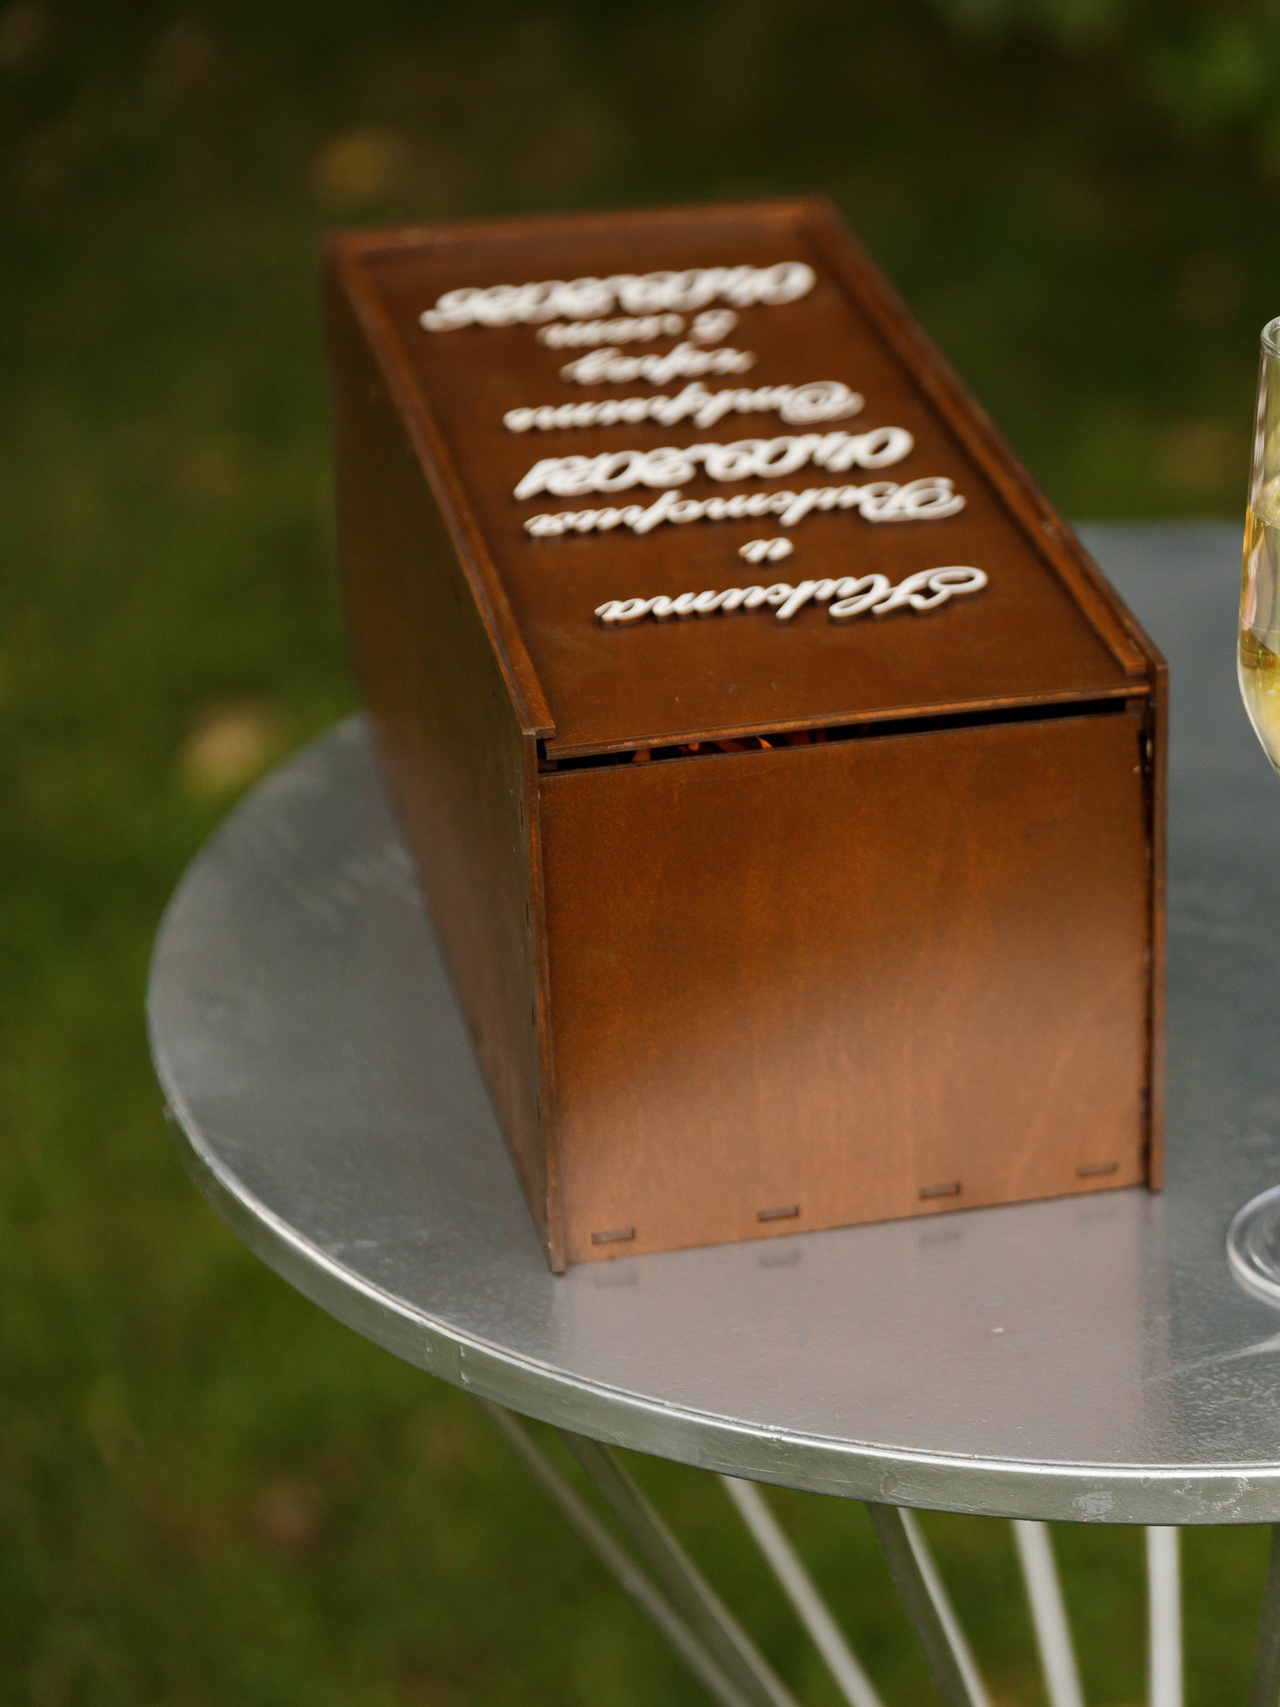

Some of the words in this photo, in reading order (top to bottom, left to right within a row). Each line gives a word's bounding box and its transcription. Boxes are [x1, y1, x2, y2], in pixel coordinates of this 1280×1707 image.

[524, 477, 965, 537] Виктория
[738, 537, 793, 563] и
[594, 565, 987, 621] Никита
